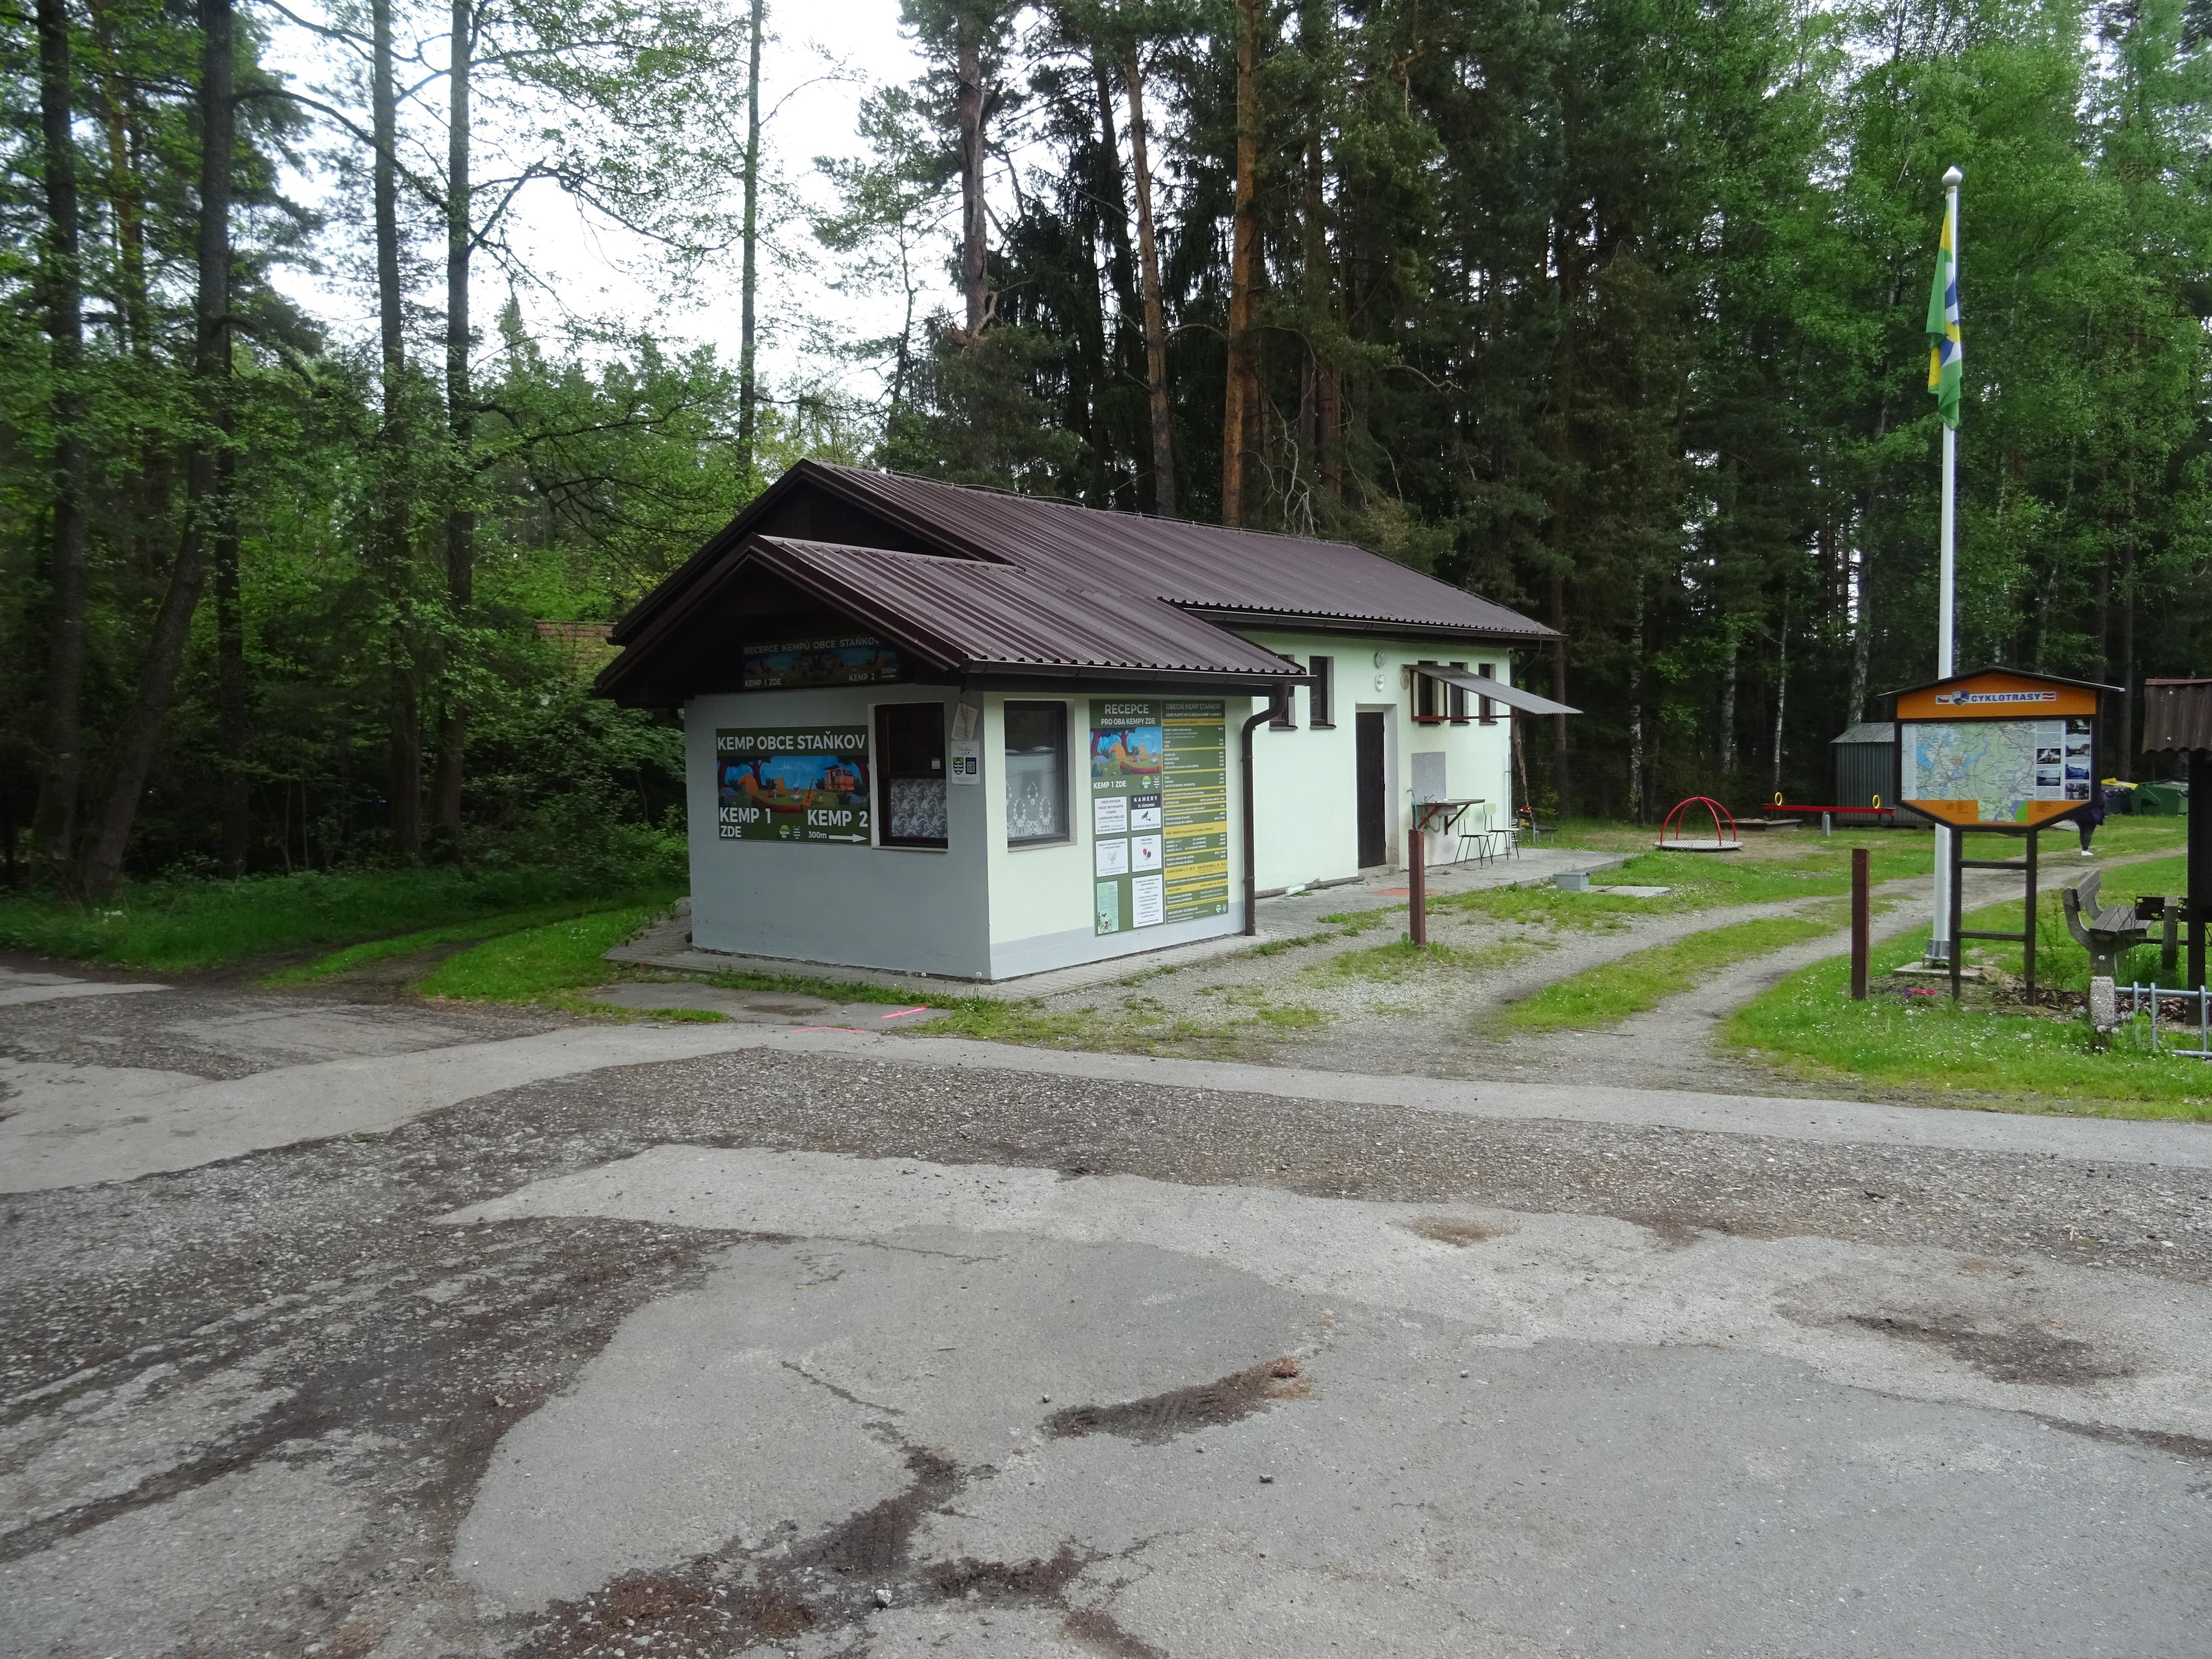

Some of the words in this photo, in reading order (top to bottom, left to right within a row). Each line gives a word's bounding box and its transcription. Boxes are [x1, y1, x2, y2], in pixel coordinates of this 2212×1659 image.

[744, 644, 779, 655] RECEPCE
[782, 639, 810, 651] KEMPŮ
[813, 640, 836, 649] OBCE
[1971, 693, 2041, 702] CYKLOTRASY
[1104, 704, 1149, 714] RECEPCE
[717, 736, 754, 750] KEMP
[757, 735, 794, 750] OBCE
[797, 731, 865, 749] STAŇKOV
[719, 807, 760, 823] KEMP
[765, 808, 771, 823] 1
[807, 810, 852, 827] KEMP
[859, 811, 868, 827] 2
[721, 825, 742, 837] ZDE
